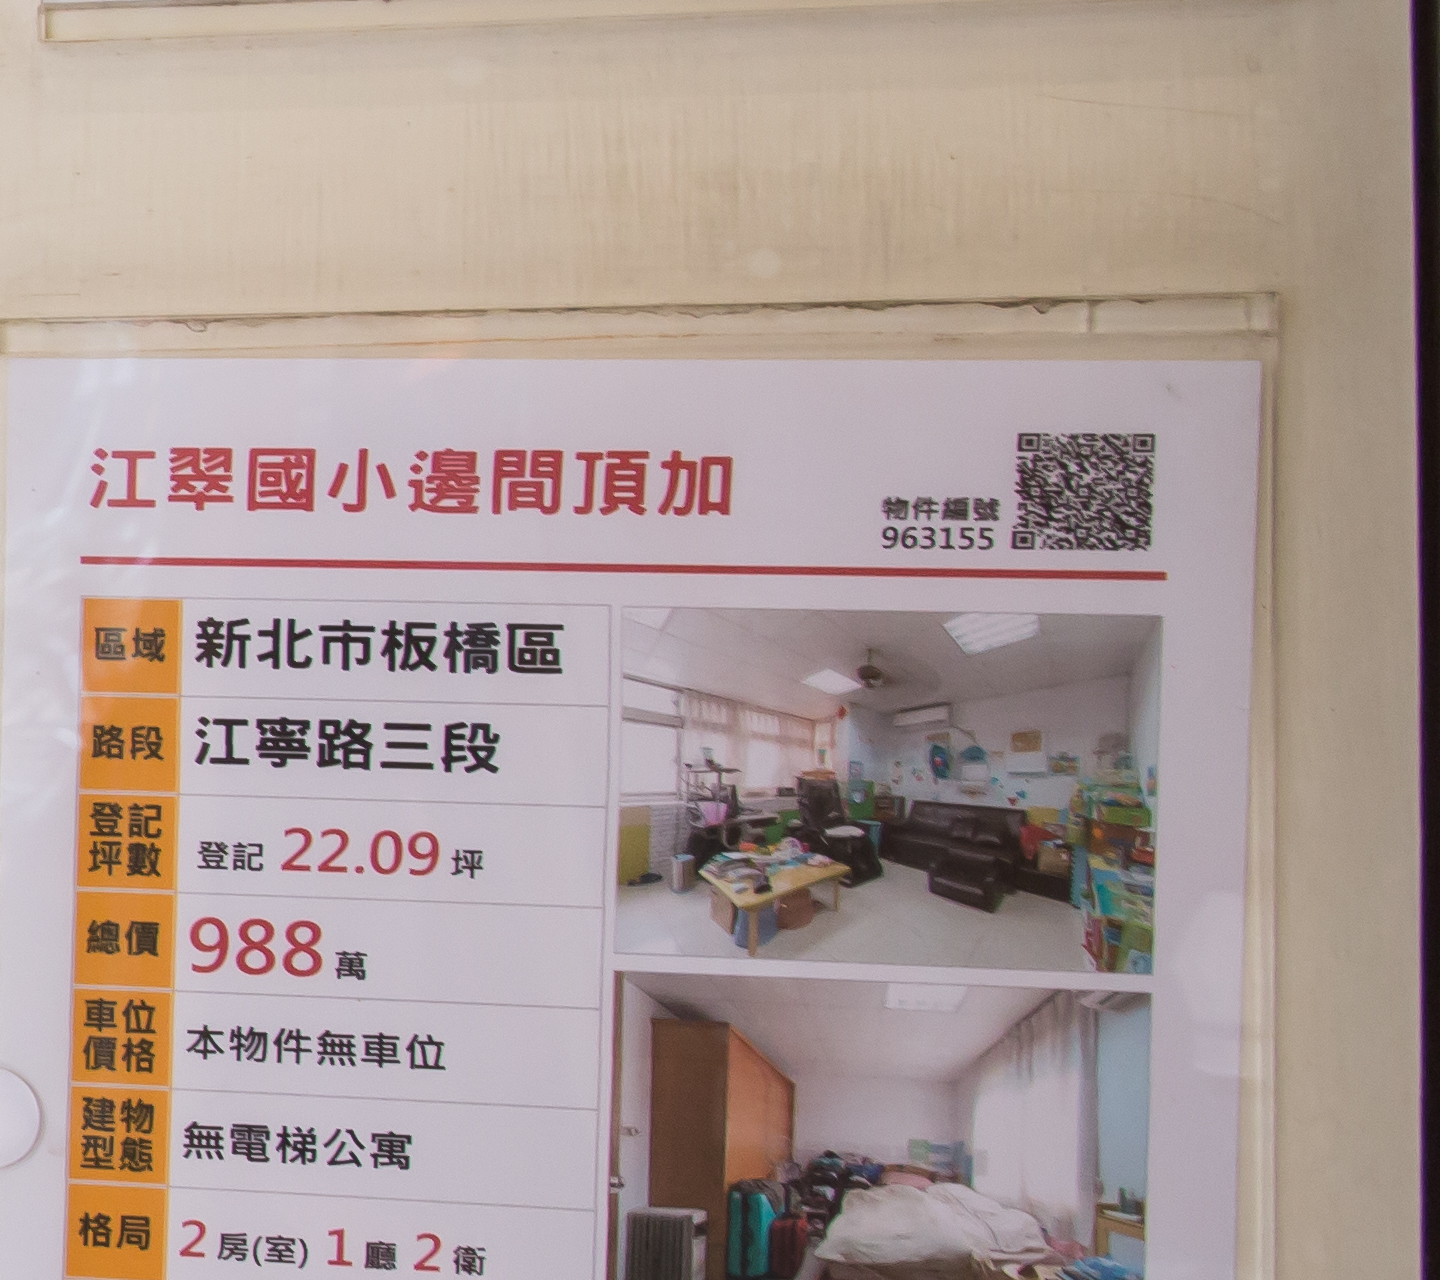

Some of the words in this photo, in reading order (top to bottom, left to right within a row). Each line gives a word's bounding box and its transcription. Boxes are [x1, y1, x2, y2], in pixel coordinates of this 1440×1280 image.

[89, 447, 734, 517] 江翠國小邊間頂加
[881, 525, 994, 551] 963155
[94, 626, 167, 663] 區域
[194, 616, 565, 675] 新北市板橋區
[91, 724, 165, 761] 路段
[194, 716, 501, 774] 江寧路三段
[89, 801, 163, 840] 登記
[88, 840, 162, 878] 坪數
[197, 840, 264, 872] 登記
[280, 827, 440, 877] 22.09
[450, 849, 484, 880] 坪
[86, 919, 160, 958] 總價
[189, 916, 323, 978] 988
[334, 950, 368, 981] 萬
[83, 997, 157, 1035] 車位
[82, 1034, 156, 1074] 價格
[186, 1024, 446, 1071] 本物件無車位
[81, 1095, 156, 1135] 建物
[80, 1134, 154, 1173] 型態
[182, 1121, 413, 1171] 無電梯公寓
[78, 1211, 152, 1252] 格局
[178, 1219, 207, 1258] 2
[216, 1232, 309, 1270] 房(室)
[327, 1228, 353, 1267] 1
[363, 1240, 397, 1271] 廳
[413, 1232, 442, 1272] 2
[452, 1245, 486, 1276] 衛
